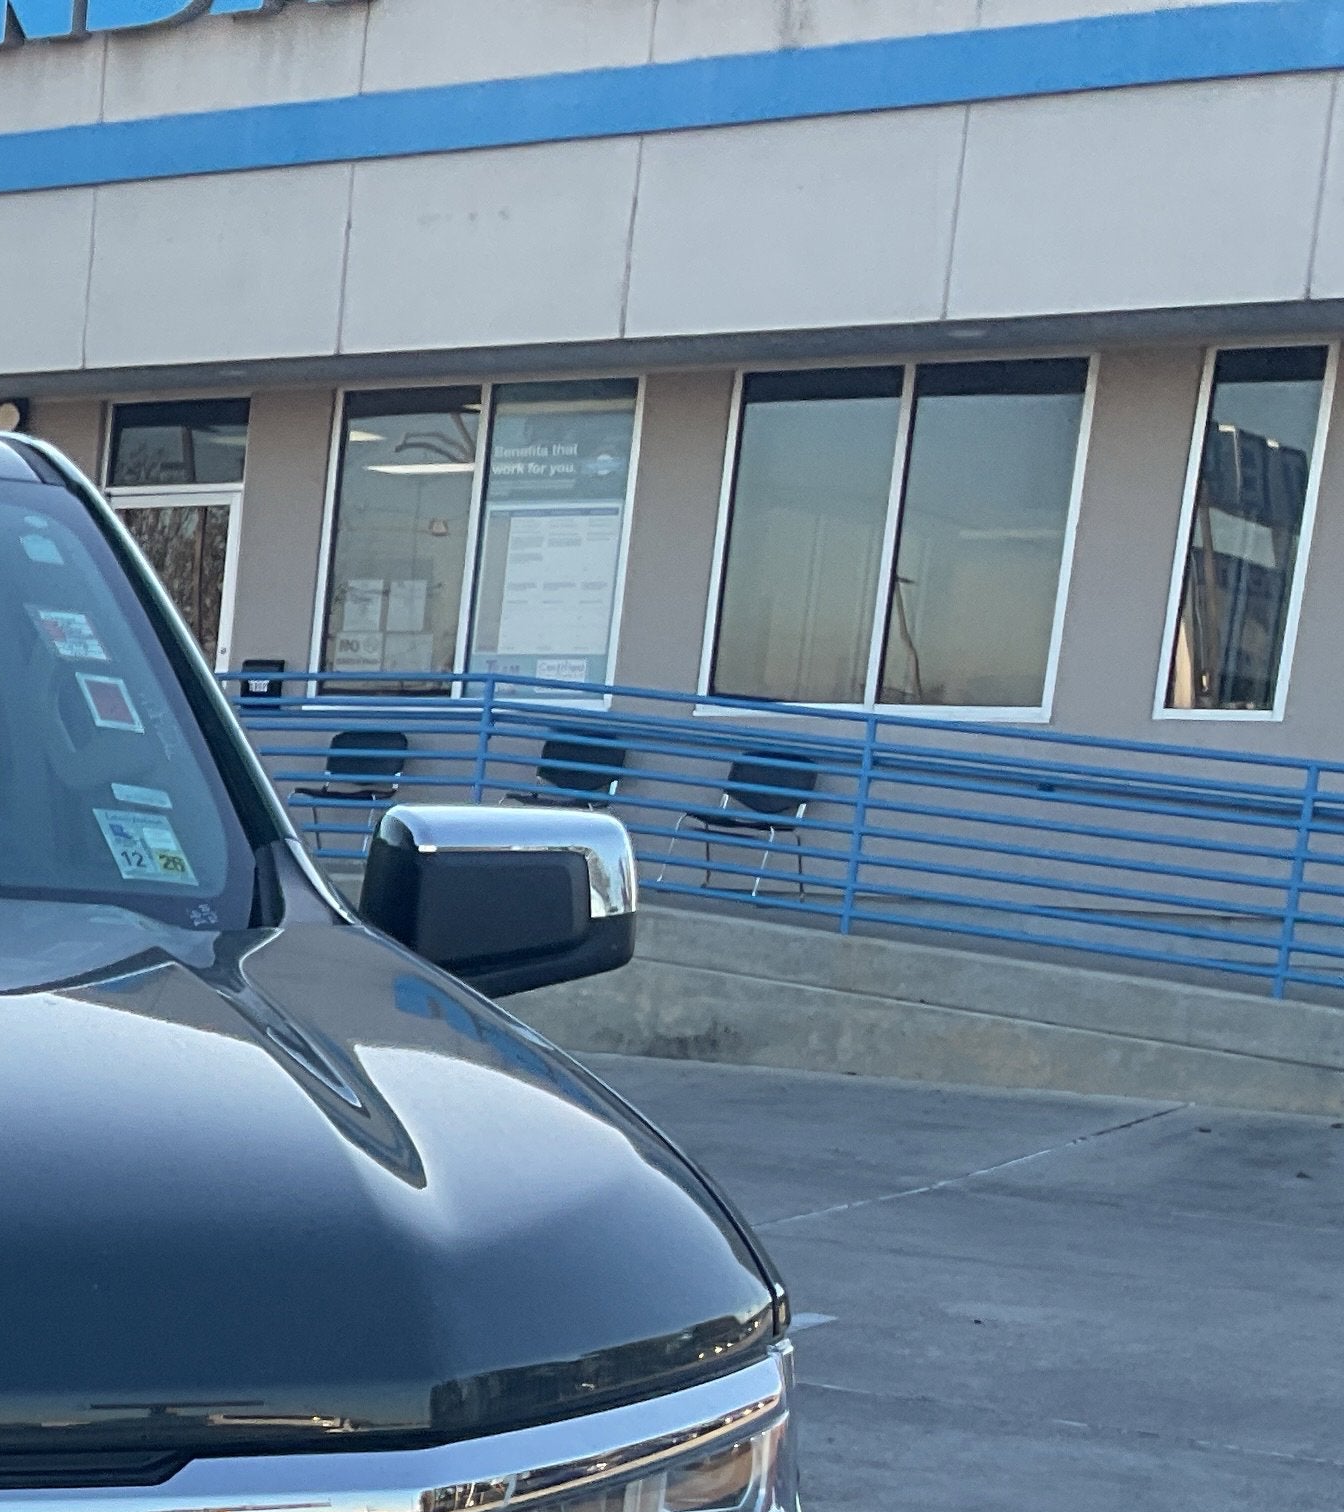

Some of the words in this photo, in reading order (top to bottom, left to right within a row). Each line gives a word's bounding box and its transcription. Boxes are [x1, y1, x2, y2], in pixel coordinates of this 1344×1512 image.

[493, 445, 549, 458] Benefits
[552, 443, 579, 457] that
[491, 462, 525, 475] work
[527, 462, 547, 474] for
[549, 463, 577, 477] you.
[120, 850, 148, 868] 12
